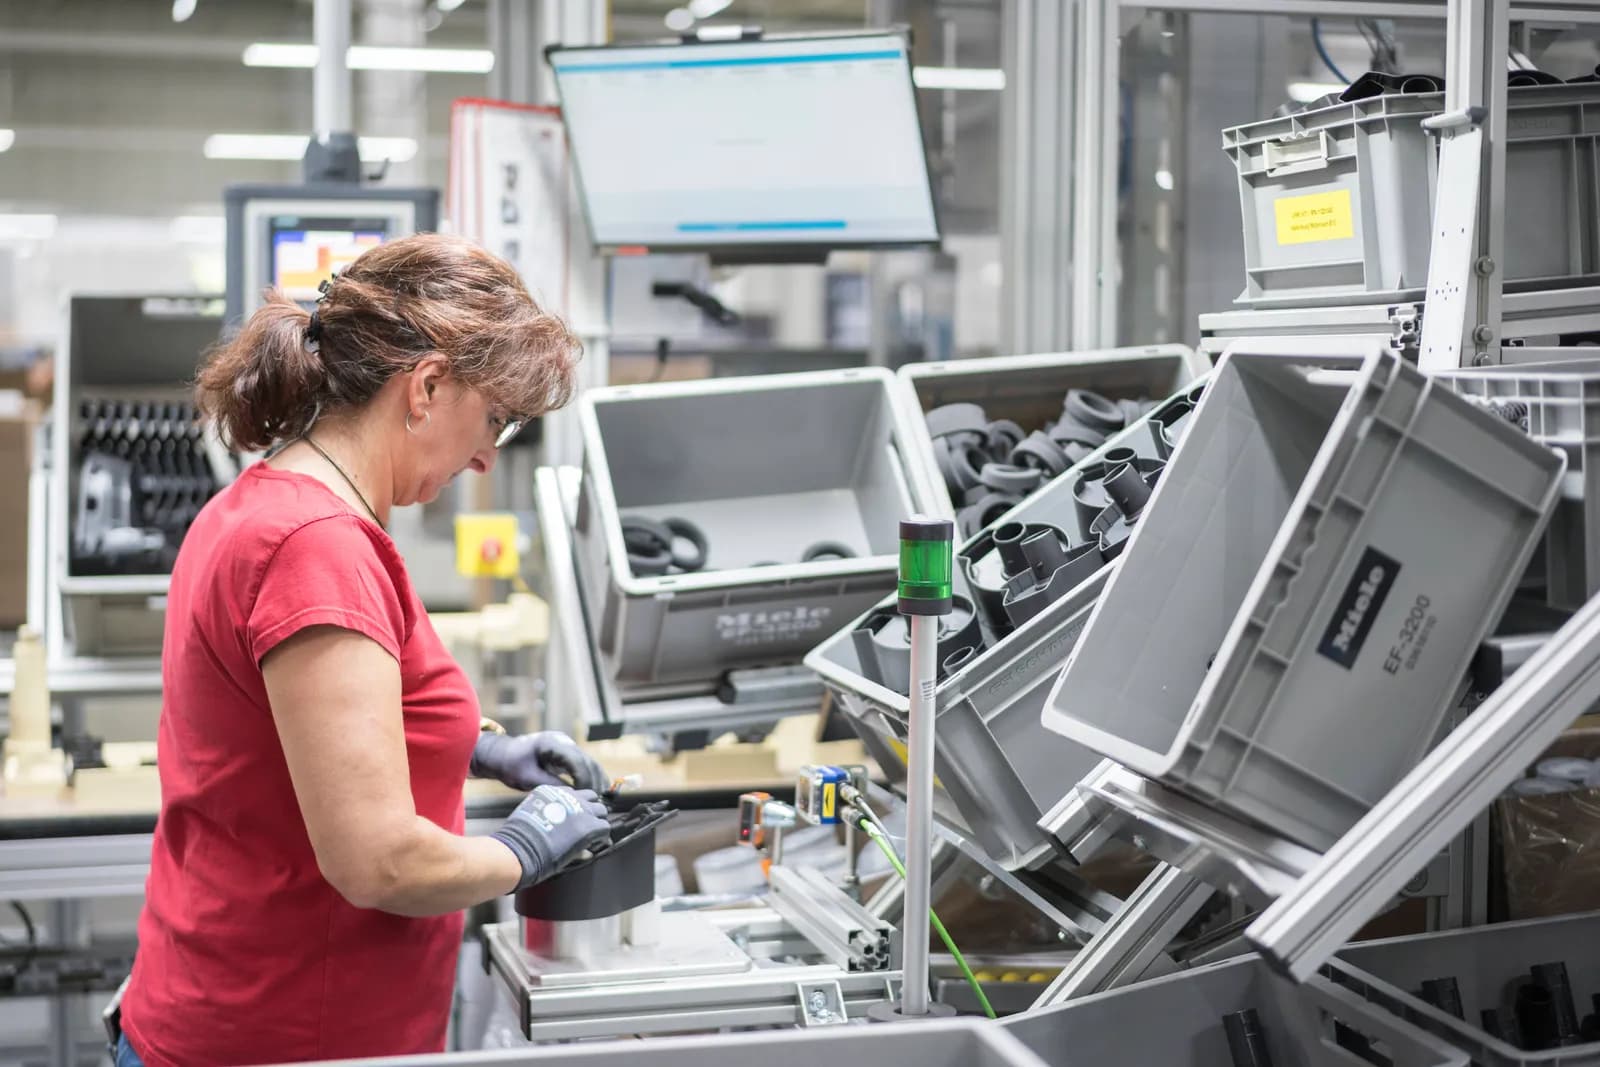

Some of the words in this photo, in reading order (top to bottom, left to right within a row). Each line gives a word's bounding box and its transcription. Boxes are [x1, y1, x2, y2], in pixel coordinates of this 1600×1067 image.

[716, 607, 831, 630] Miele
[1332, 565, 1385, 652] Miele
[1383, 594, 1431, 675] EF-3200
